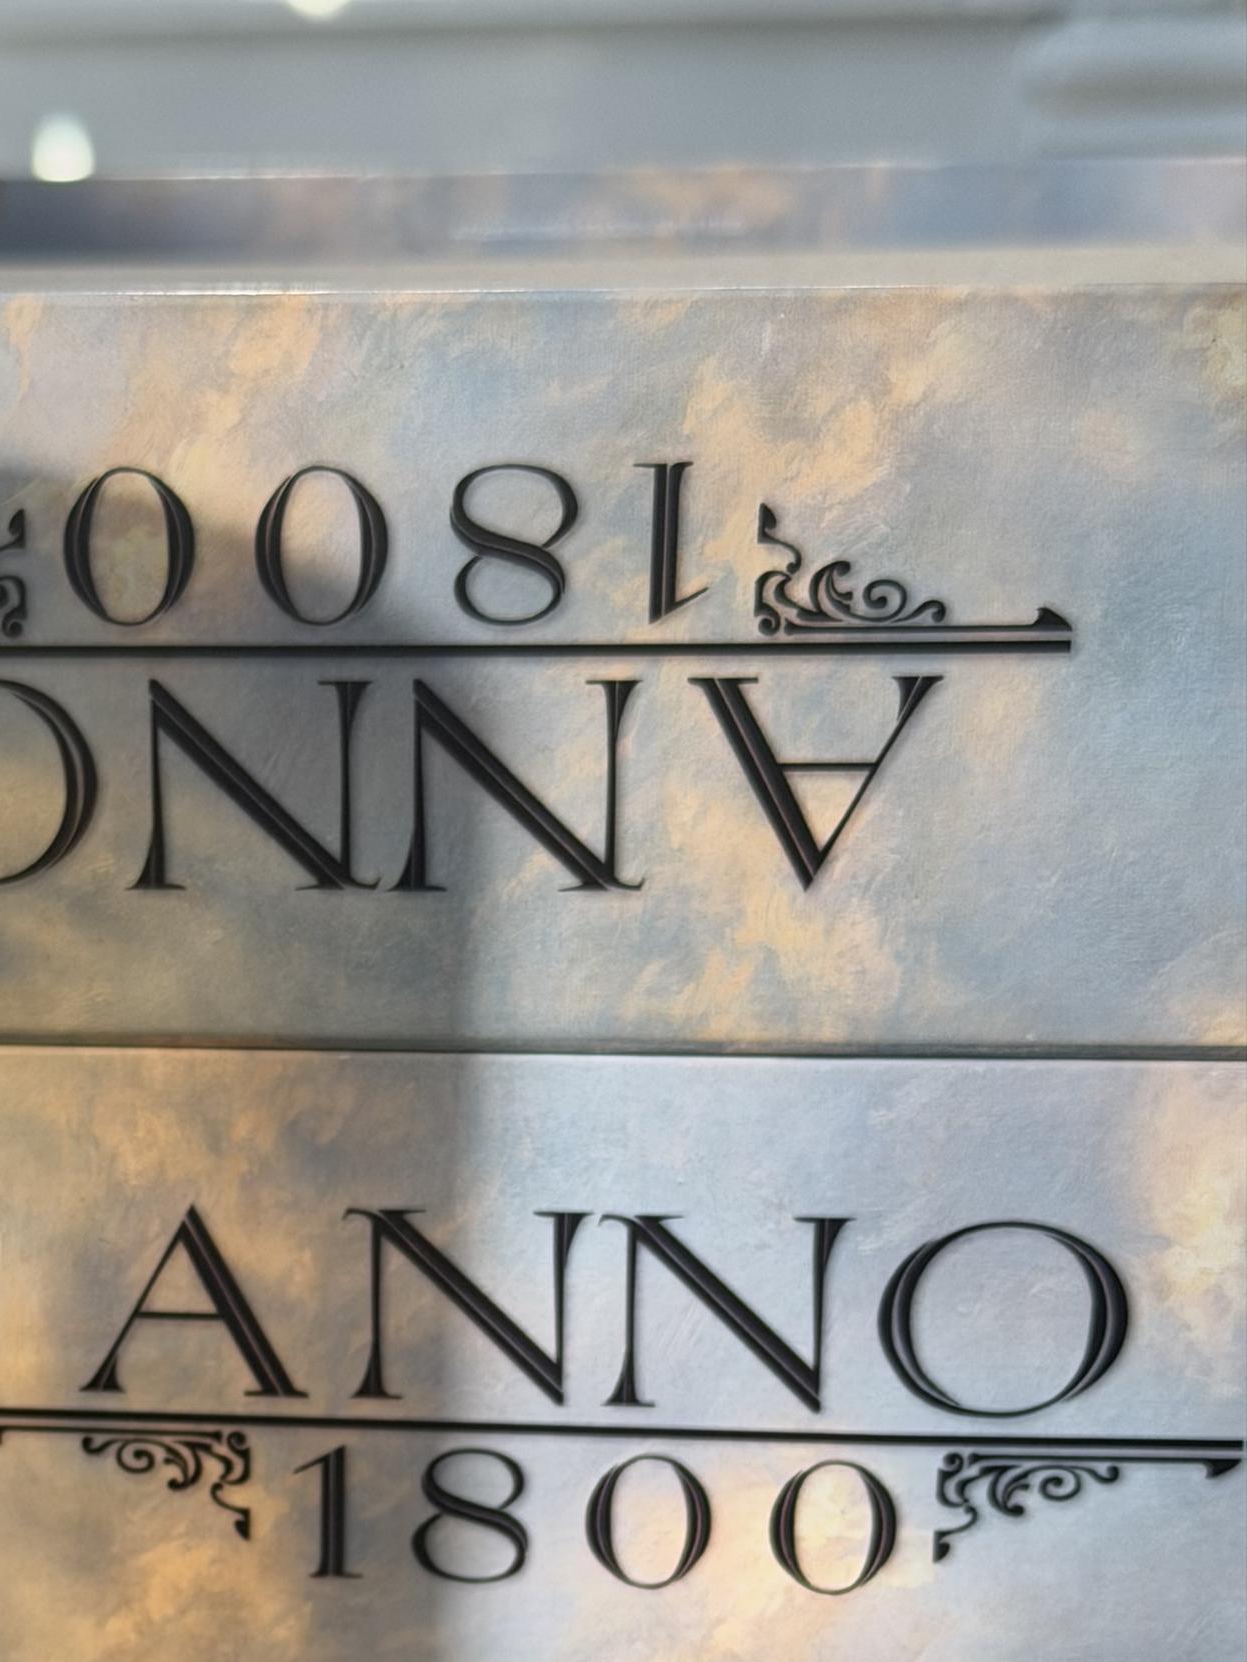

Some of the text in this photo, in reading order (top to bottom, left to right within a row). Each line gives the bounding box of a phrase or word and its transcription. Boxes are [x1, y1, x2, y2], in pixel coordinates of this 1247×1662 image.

[61, 460, 711, 630] 1800
[78, 1203, 1131, 1420] ANNO
[293, 1442, 899, 1596] 1800
